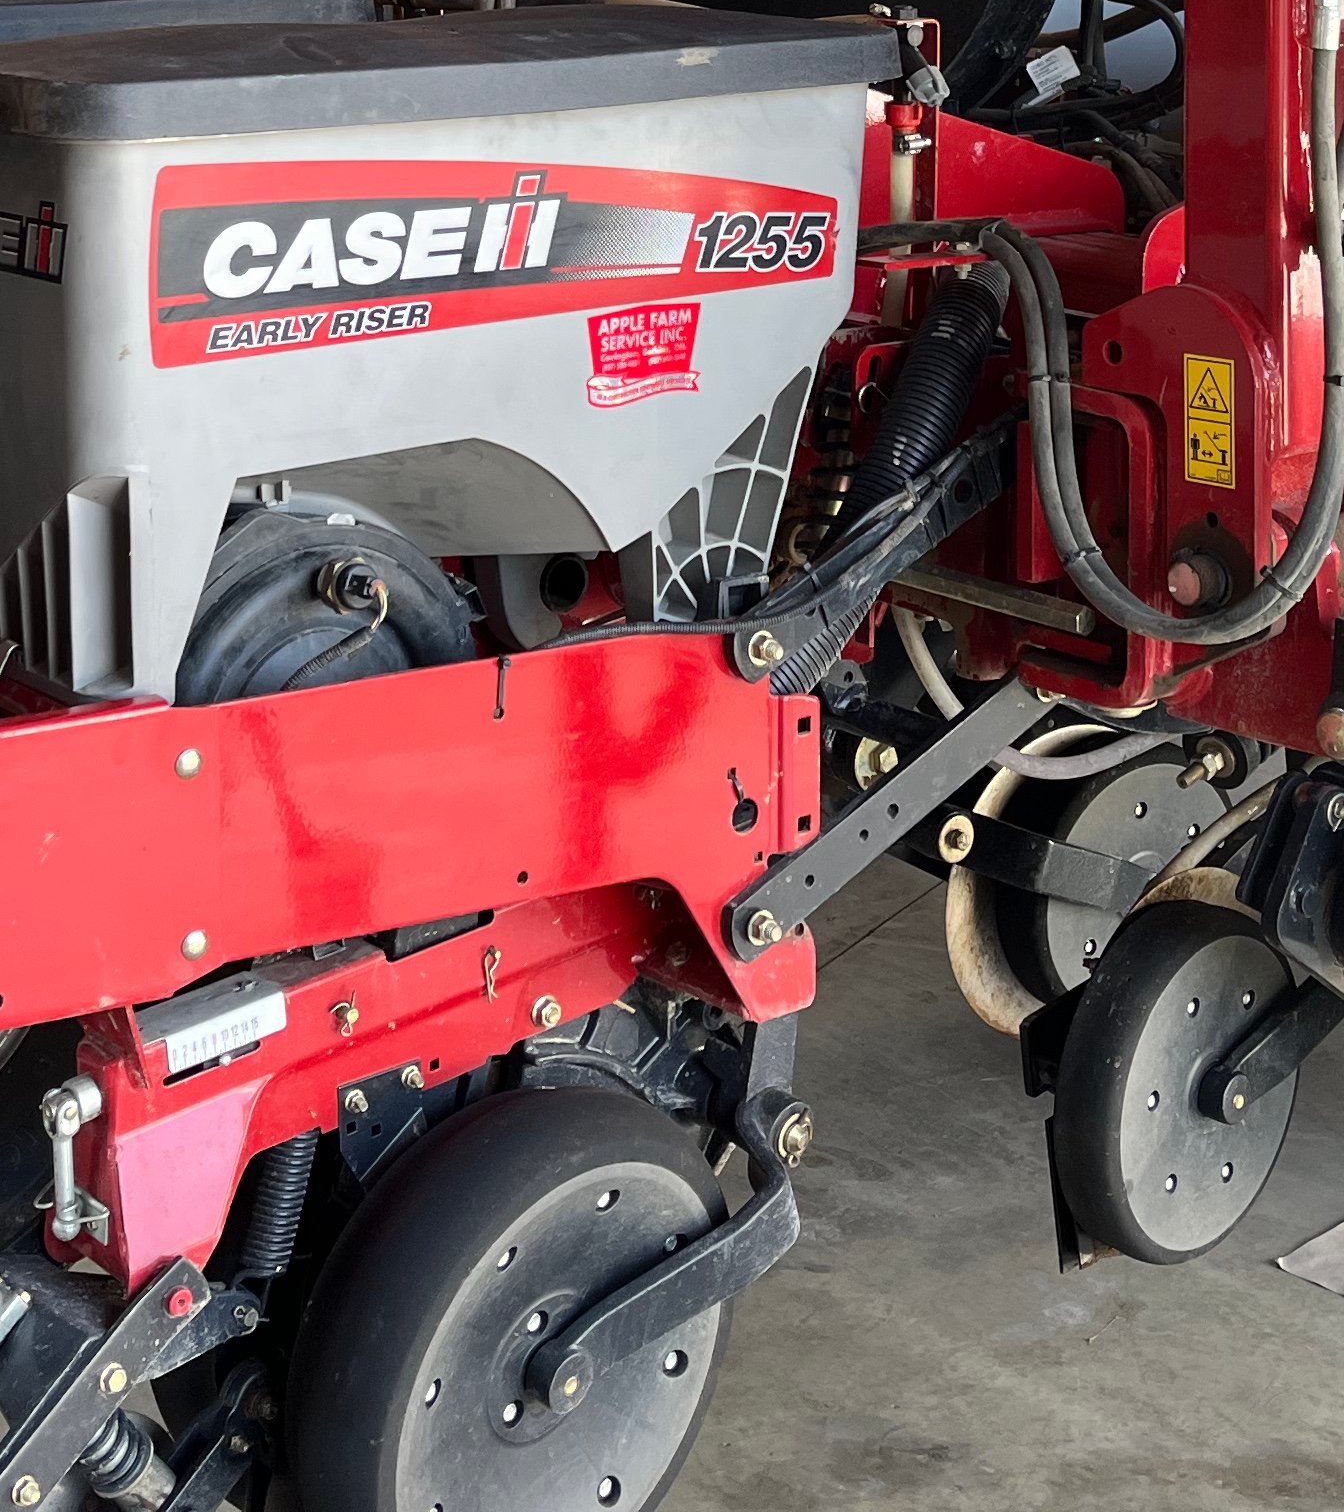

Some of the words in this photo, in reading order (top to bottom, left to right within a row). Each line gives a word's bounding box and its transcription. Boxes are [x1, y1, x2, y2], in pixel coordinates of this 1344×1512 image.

[202, 205, 471, 300] CASE
[693, 211, 832, 273] 1255
[206, 315, 324, 353] EARLY
[330, 303, 432, 338] RISER
[597, 313, 646, 337] APPLE
[649, 307, 693, 329] FARM
[600, 330, 657, 353] SERVICE
